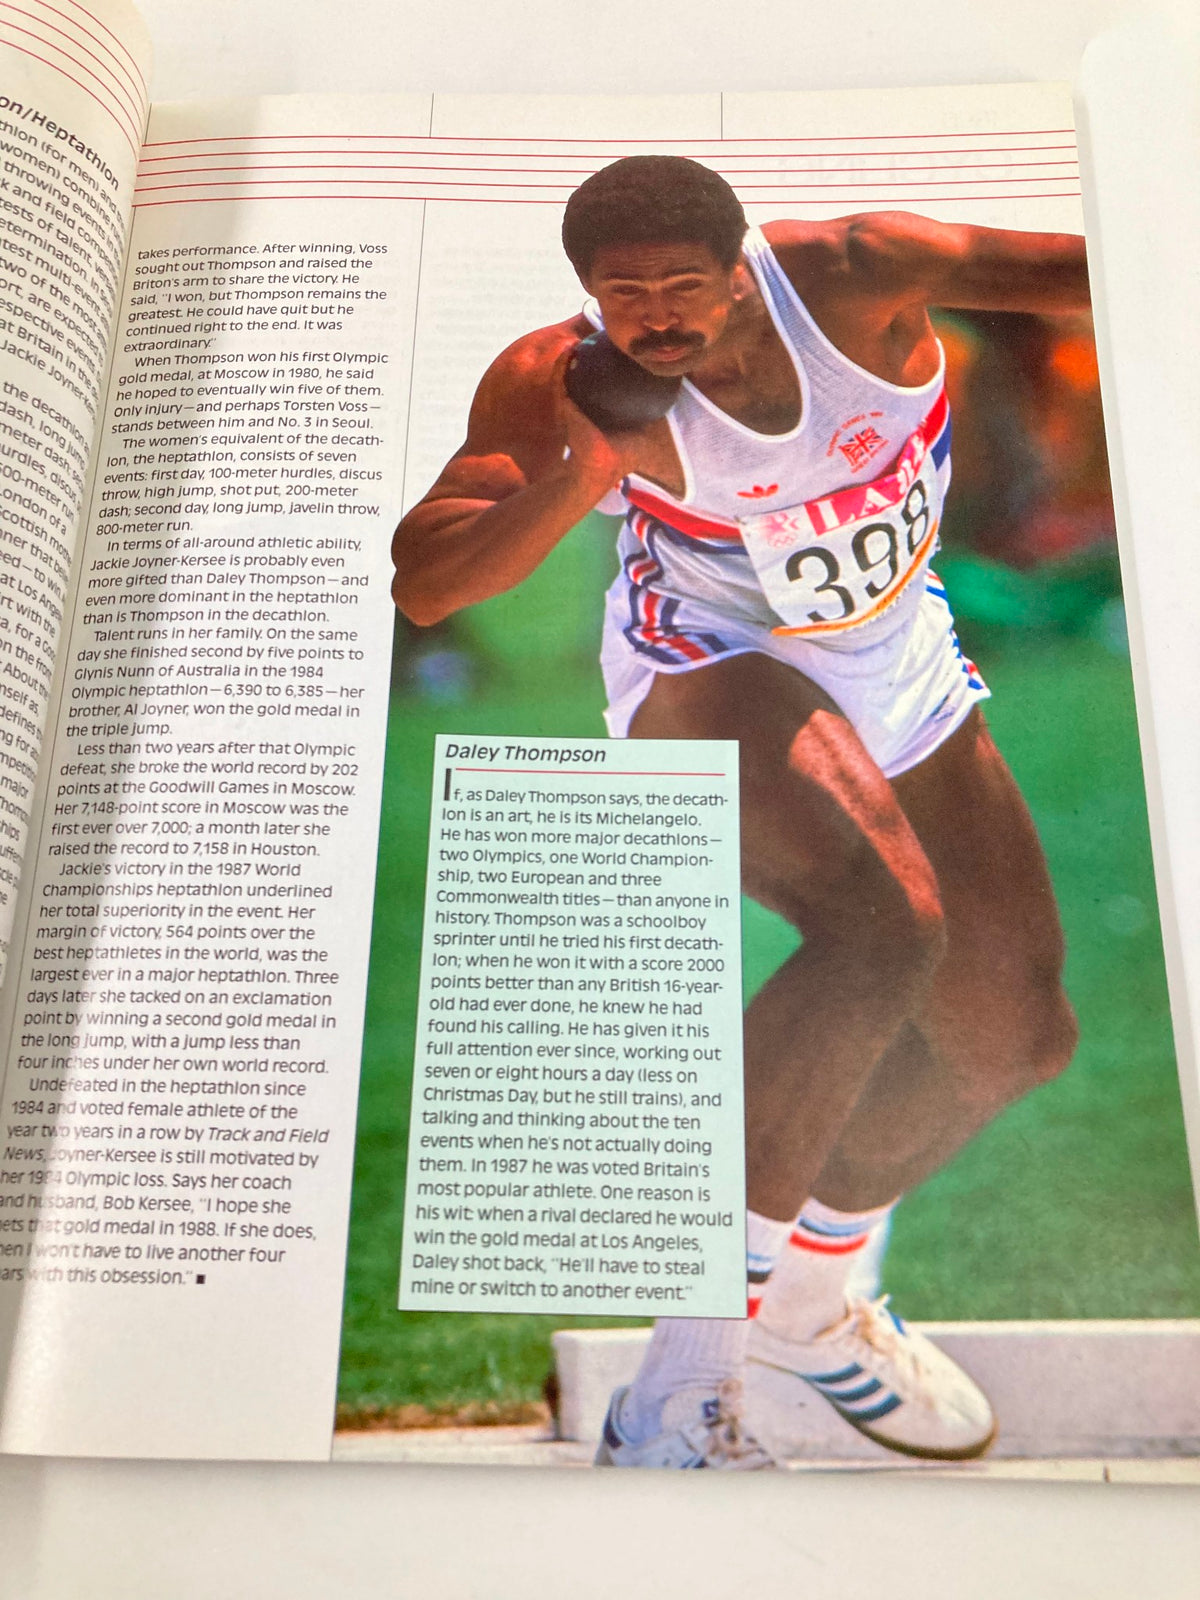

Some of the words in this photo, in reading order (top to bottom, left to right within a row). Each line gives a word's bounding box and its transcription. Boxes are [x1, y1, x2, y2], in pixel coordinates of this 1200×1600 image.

[41, 141, 67, 163] (for
[69, 160, 99, 192] men)
[0, 140, 61, 180] women)
[62, 176, 111, 225] combine
[4, 161, 70, 207] throwing
[72, 203, 106, 240] events
[12, 185, 42, 207] and
[45, 201, 76, 230] field
[37, 218, 54, 233] of
[138, 249, 170, 260] takes
[172, 245, 259, 259] performance.
[262, 243, 296, 253] After
[298, 243, 355, 255] winning,
[359, 244, 388, 254] Voss
[135, 262, 180, 276] sought
[182, 261, 205, 272] out
[207, 260, 276, 271] Thompson
[279, 258, 305, 269] and
[307, 258, 348, 268] raised
[350, 259, 373, 269] the
[28, 293, 51, 312] are
[31, 274, 47, 288] of
[49, 284, 71, 306] the
[72, 302, 97, 333] most
[18, 326, 64, 362] Britain
[65, 356, 76, 372] in
[135, 356, 171, 367] When
[174, 353, 244, 365] Thompson
[247, 353, 276, 362] won
[279, 351, 299, 362] his
[302, 351, 331, 362] first
[333, 352, 389, 365] Olympic
[3, 381, 29, 402] the
[31, 397, 85, 447] decathlon
[39, 420, 66, 449] long
[123, 438, 146, 449] The
[149, 435, 208, 447] women's
[210, 433, 284, 446] equivalent
[286, 433, 302, 444] of
[305, 434, 328, 445] the
[331, 434, 384, 446] decath-
[785, 479, 929, 623] 398
[90, 557, 130, 571] Jackie
[131, 555, 226, 569] Joyner-Kersee
[229, 554, 240, 566] is
[243, 555, 308, 568] probably
[311, 557, 345, 567] even
[16, 602, 42, 626] with
[3, 663, 39, 691] About
[74, 666, 113, 681] Glynis
[117, 666, 155, 678] Nunn
[158, 664, 174, 677] of
[176, 664, 241, 677] Australia
[244, 664, 258, 677] in
[262, 665, 287, 677] the
[290, 665, 323, 678] 1984
[77, 744, 105, 756] Less
[109, 742, 141, 755] than
[145, 742, 173, 754] two
[176, 743, 215, 755] years
[218, 741, 256, 754] after
[259, 742, 291, 755] that
[294, 742, 356, 758] Olympic
[445, 744, 500, 762] Daley
[504, 745, 606, 764] Thompson
[57, 782, 100, 798] points
[103, 782, 119, 794] at
[122, 781, 146, 794] the
[149, 781, 215, 794] Goodwill
[218, 781, 269, 794] Games
[273, 781, 287, 794] in
[291, 782, 355, 796] Moscow.
[439, 849, 469, 862] two
[472, 849, 545, 865] Olympics,
[549, 852, 579, 864] one
[581, 852, 627, 865] World
[630, 852, 713, 868] Champion-
[59, 862, 112, 876] Jackie's
[114, 862, 166, 877] victory
[169, 862, 183, 875] in
[187, 862, 213, 875] the
[216, 862, 252, 876] 1987
[255, 863, 301, 877] World
[437, 869, 474, 884] ship,
[477, 871, 508, 883] two
[511, 870, 584, 886] European
[588, 873, 617, 886] and
[621, 873, 662, 886] three
[42, 882, 153, 898] Championships
[156, 883, 243, 897] heptathlon
[247, 884, 333, 898] underlined
[39, 905, 63, 918] her
[66, 904, 100, 917] total
[103, 903, 186, 919] superiority
[188, 904, 203, 917] in
[207, 904, 233, 918] the
[237, 906, 283, 919] event.
[288, 906, 316, 919] Her
[435, 910, 490, 926] history.
[494, 912, 576, 928] Thompson
[580, 915, 610, 928] was
[613, 916, 623, 928] a
[626, 914, 707, 931] schoolboy
[431, 975, 481, 990] points
[485, 975, 534, 990] better
[538, 977, 574, 991] than
[577, 979, 606, 993] any
[610, 978, 660, 992] British
[663, 979, 723, 995] 16-year-
[423, 1087, 504, 1103] Christmas
[508, 1088, 538, 1105] Day,
[543, 1088, 572, 1104] but
[575, 1090, 595, 1104] he
[598, 1090, 627, 1105] still
[632, 1091, 686, 1108] trains),
[690, 1093, 722, 1107] and
[12, 1100, 44, 1115] 1984
[47, 1100, 77, 1115] and
[79, 1101, 124, 1116] voted
[127, 1101, 184, 1117] female
[186, 1103, 245, 1118] athlete
[249, 1104, 267, 1119] of
[271, 1105, 298, 1119] the
[422, 1110, 479, 1128] talking
[482, 1111, 513, 1126] and
[517, 1111, 585, 1130] thinking
[589, 1113, 639, 1129] about
[642, 1114, 669, 1129] the
[673, 1116, 701, 1130] ten
[419, 1157, 467, 1172] them.
[471, 1158, 487, 1173] In
[491, 1158, 528, 1174] 1987
[532, 1159, 553, 1174] he
[556, 1161, 589, 1175] was
[592, 1161, 639, 1176] voted
[644, 1162, 710, 1178] Britain's
[414, 1229, 445, 1244] win
[449, 1230, 478, 1246] the
[480, 1231, 519, 1248] gold
[523, 1232, 576, 1248] medal
[580, 1235, 598, 1248] at
[601, 1234, 629, 1249] Los
[632, 1234, 703, 1253] Angeles,
